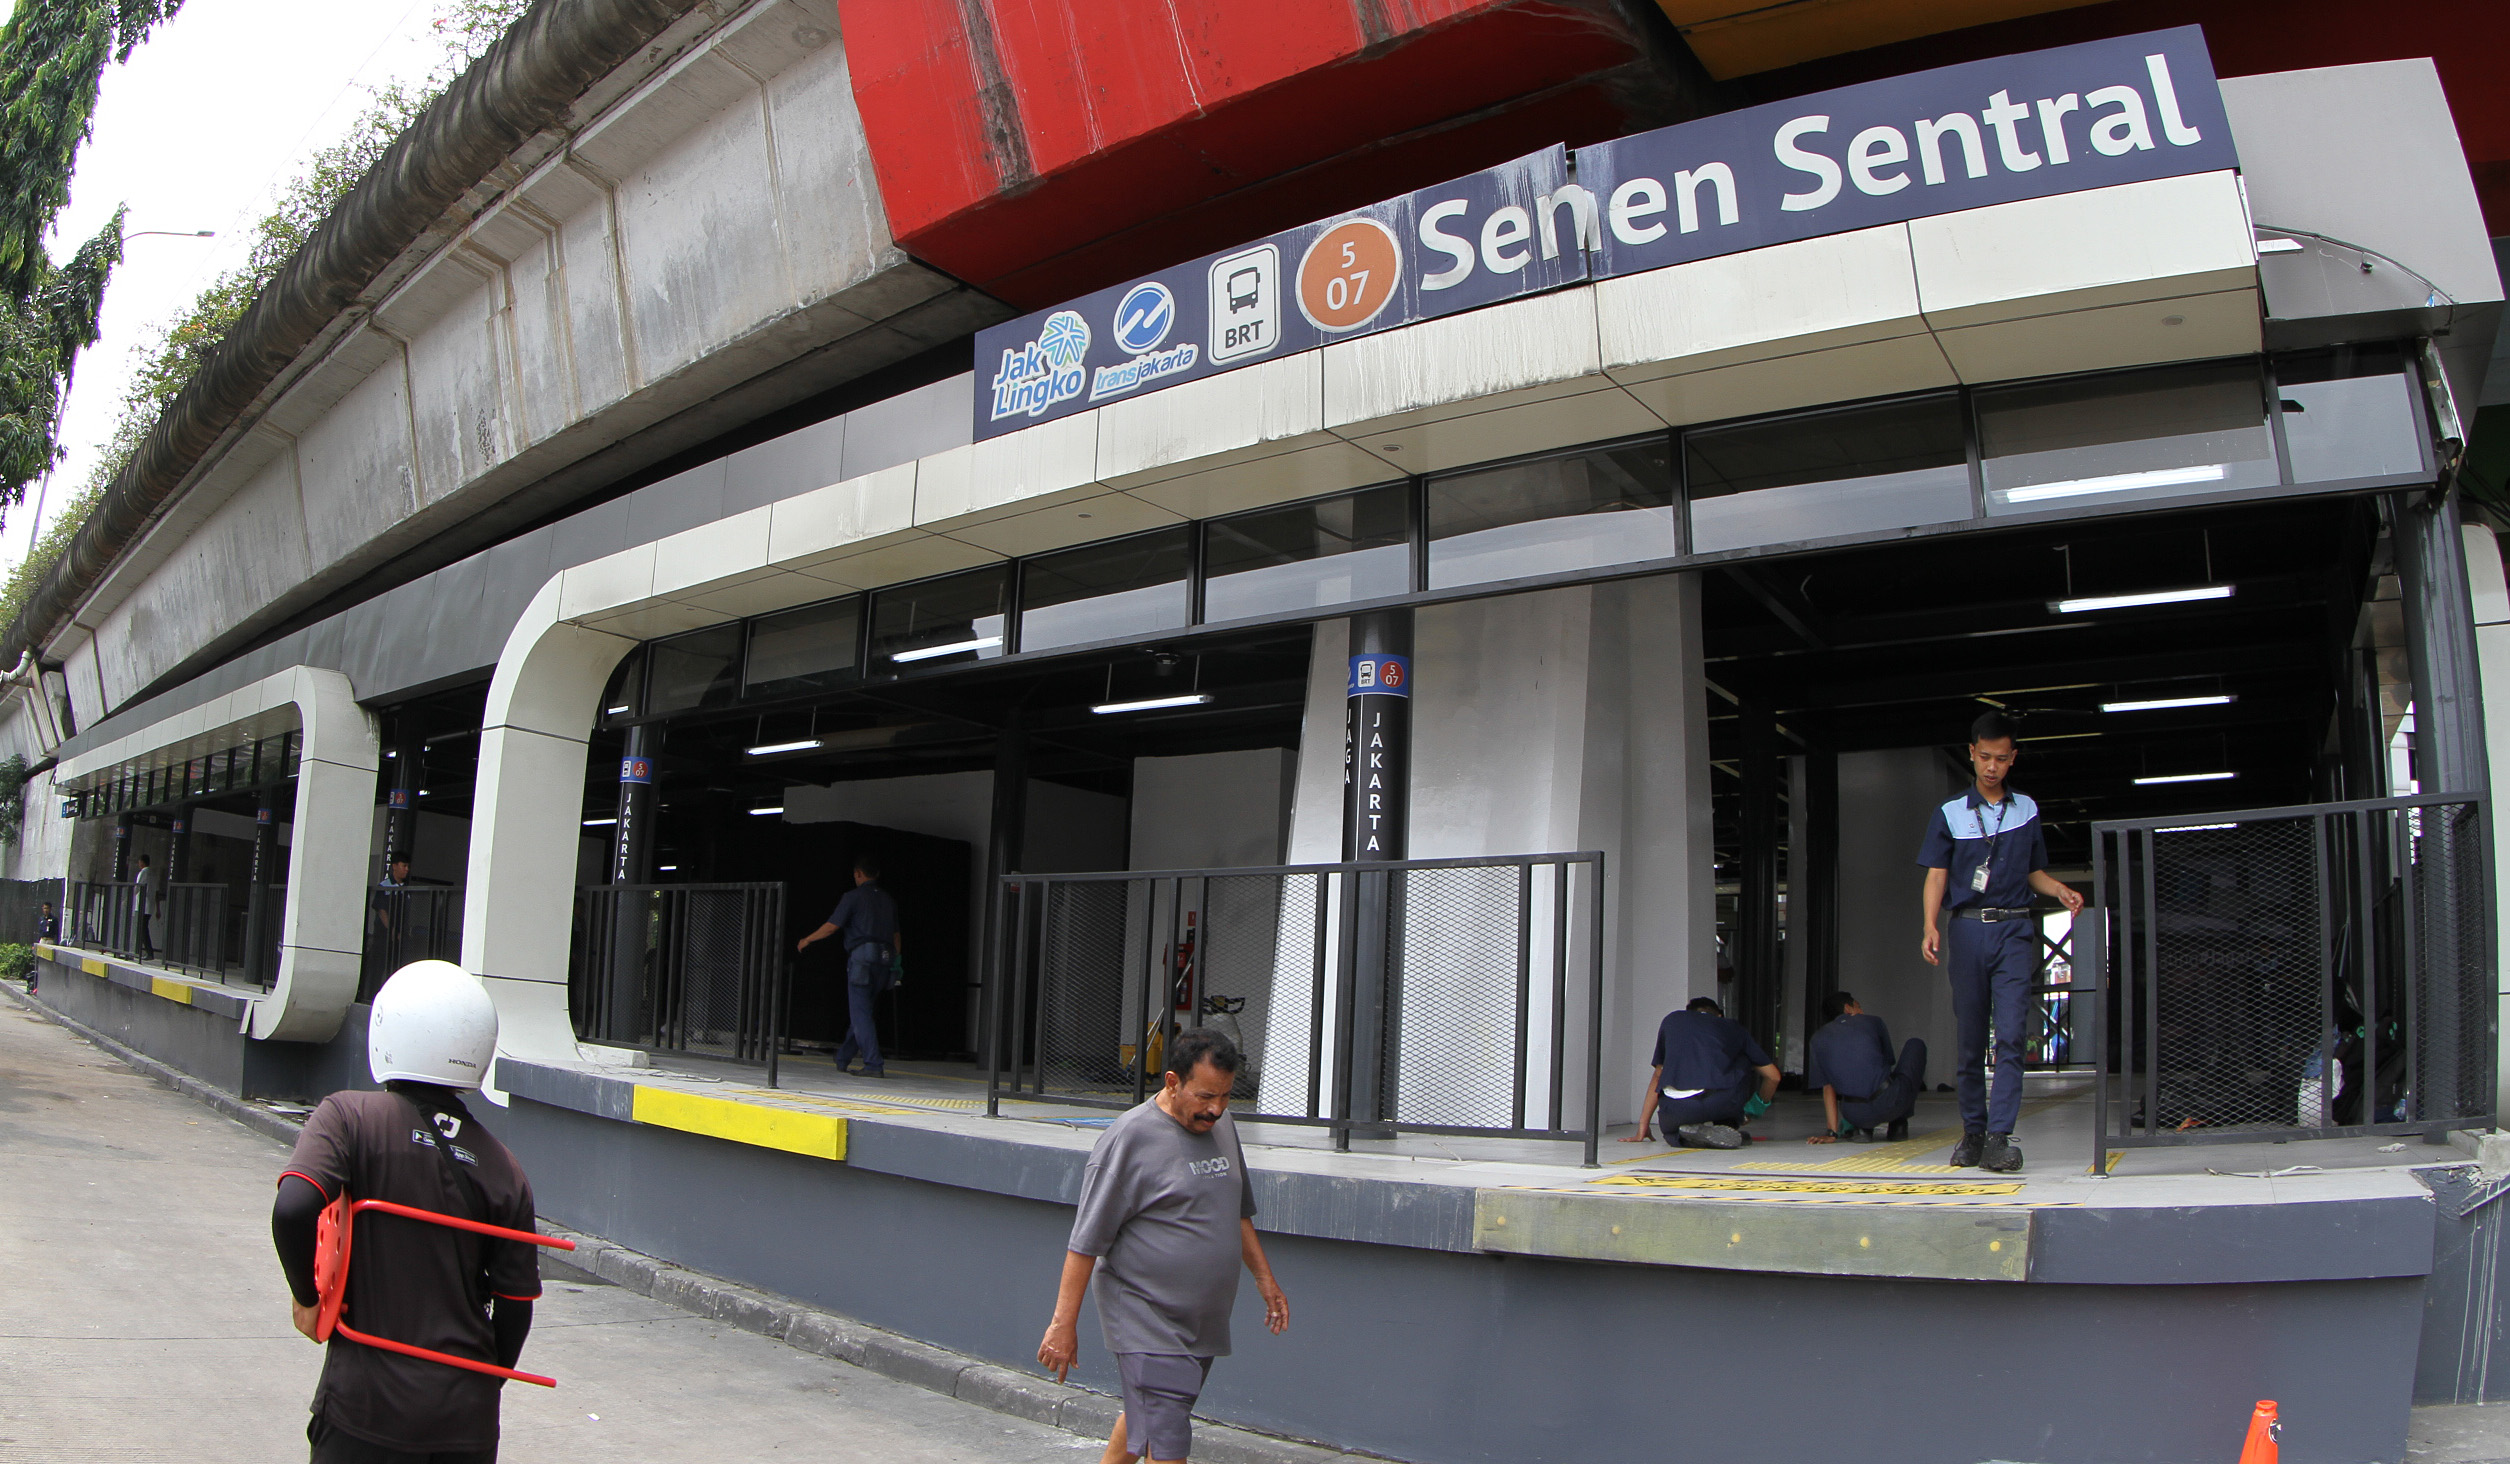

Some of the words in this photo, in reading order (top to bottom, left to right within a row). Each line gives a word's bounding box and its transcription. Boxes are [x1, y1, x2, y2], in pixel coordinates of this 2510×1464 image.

[1419, 161, 1740, 291] Senen
[1773, 53, 2202, 212] Sentral
[1341, 241, 1356, 269] 5
[1326, 270, 1371, 311] 07
[1225, 319, 1264, 349] BRT
[996, 346, 1043, 385] Jak
[1096, 347, 1195, 391] transjakarta
[994, 368, 1083, 416] Lingko
[1385, 674, 1399, 685] 07
[1389, 664, 1396, 675] 5
[1344, 708, 1352, 785] JAGA
[635, 769, 645, 777] 07
[1366, 712, 1384, 851] JAKARTA
[253, 829, 261, 881] JAKARTA
[384, 816, 395, 880] JAKARTA
[617, 793, 632, 879] JAKARTA
[448, 1058, 477, 1069] HONDA
[1189, 1156, 1230, 1176] MOOD
